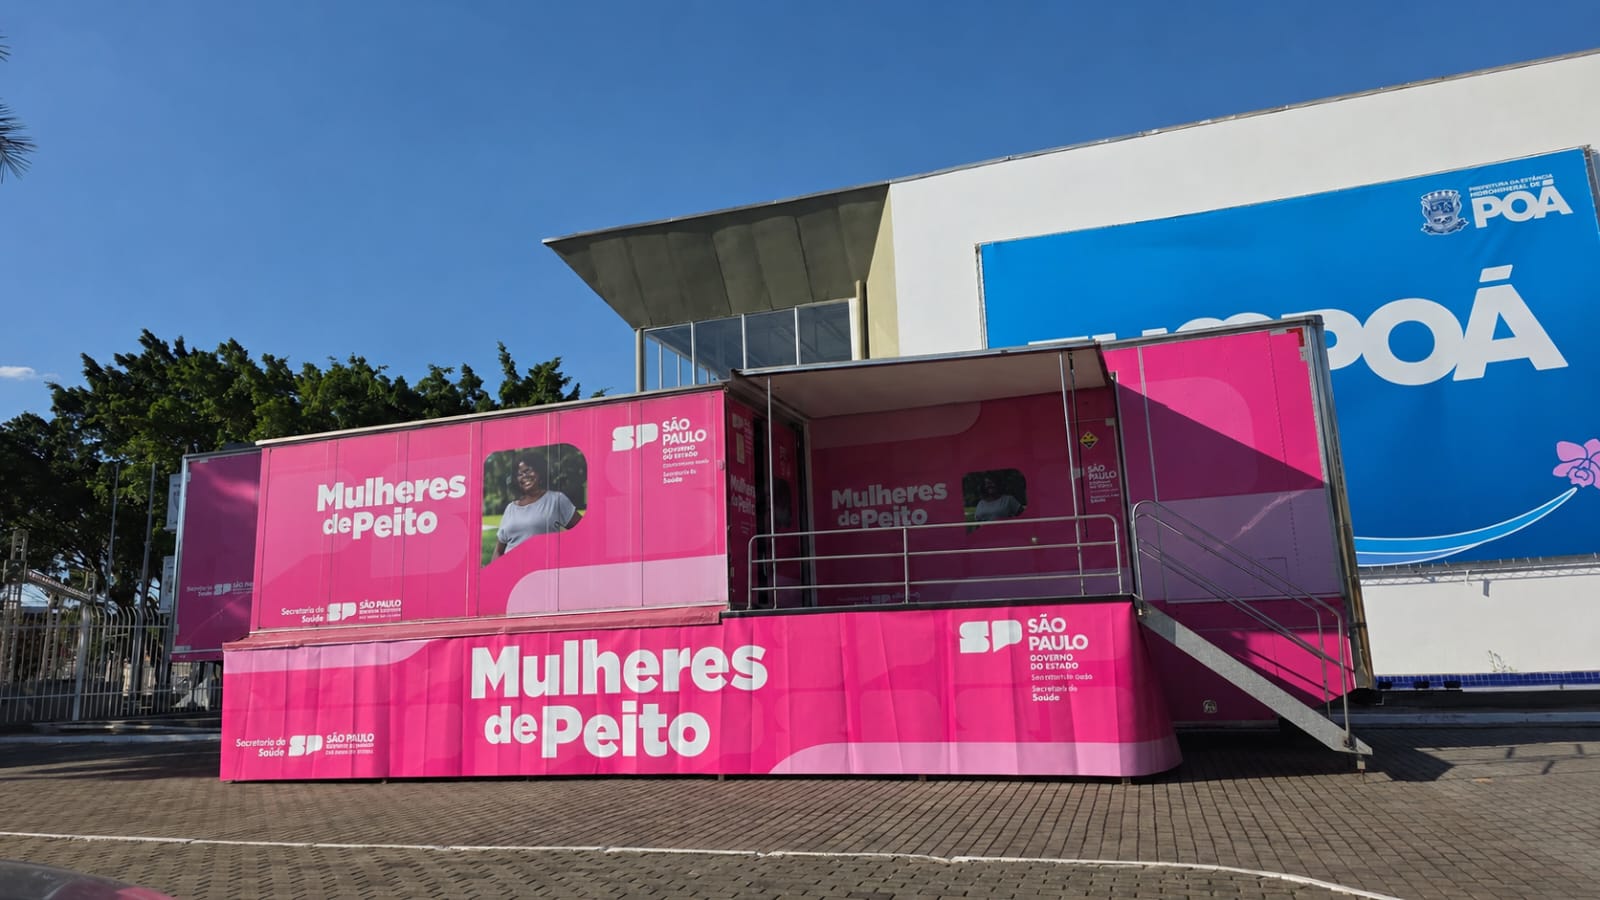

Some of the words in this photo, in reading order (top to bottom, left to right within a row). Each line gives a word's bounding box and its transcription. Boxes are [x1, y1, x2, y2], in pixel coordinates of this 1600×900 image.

[1471, 179, 1574, 229] POÁ
[662, 416, 690, 432] SÃO
[662, 429, 707, 446] PAULO
[316, 475, 467, 512] Mulheres
[831, 483, 948, 510] Mulheres
[322, 513, 352, 535] de
[352, 506, 438, 540] Peito
[838, 511, 860, 526] de
[861, 505, 928, 529] Peito
[359, 600, 375, 609] SÃO
[376, 599, 401, 608] PAULO
[302, 614, 324, 623] Saúde
[1028, 614, 1066, 633] SÃO
[1028, 634, 1089, 651] PAULO
[1029, 653, 1073, 662] GOVERNO
[1030, 662, 1043, 670] DO
[1045, 661, 1079, 669] ESTADO
[471, 639, 768, 699] Mulheres
[1032, 693, 1060, 702] Saúde
[326, 732, 345, 743] SÃO
[346, 733, 375, 743] PAULO
[484, 705, 538, 744] de
[541, 700, 711, 758] Peito
[258, 747, 285, 757] Saúde
